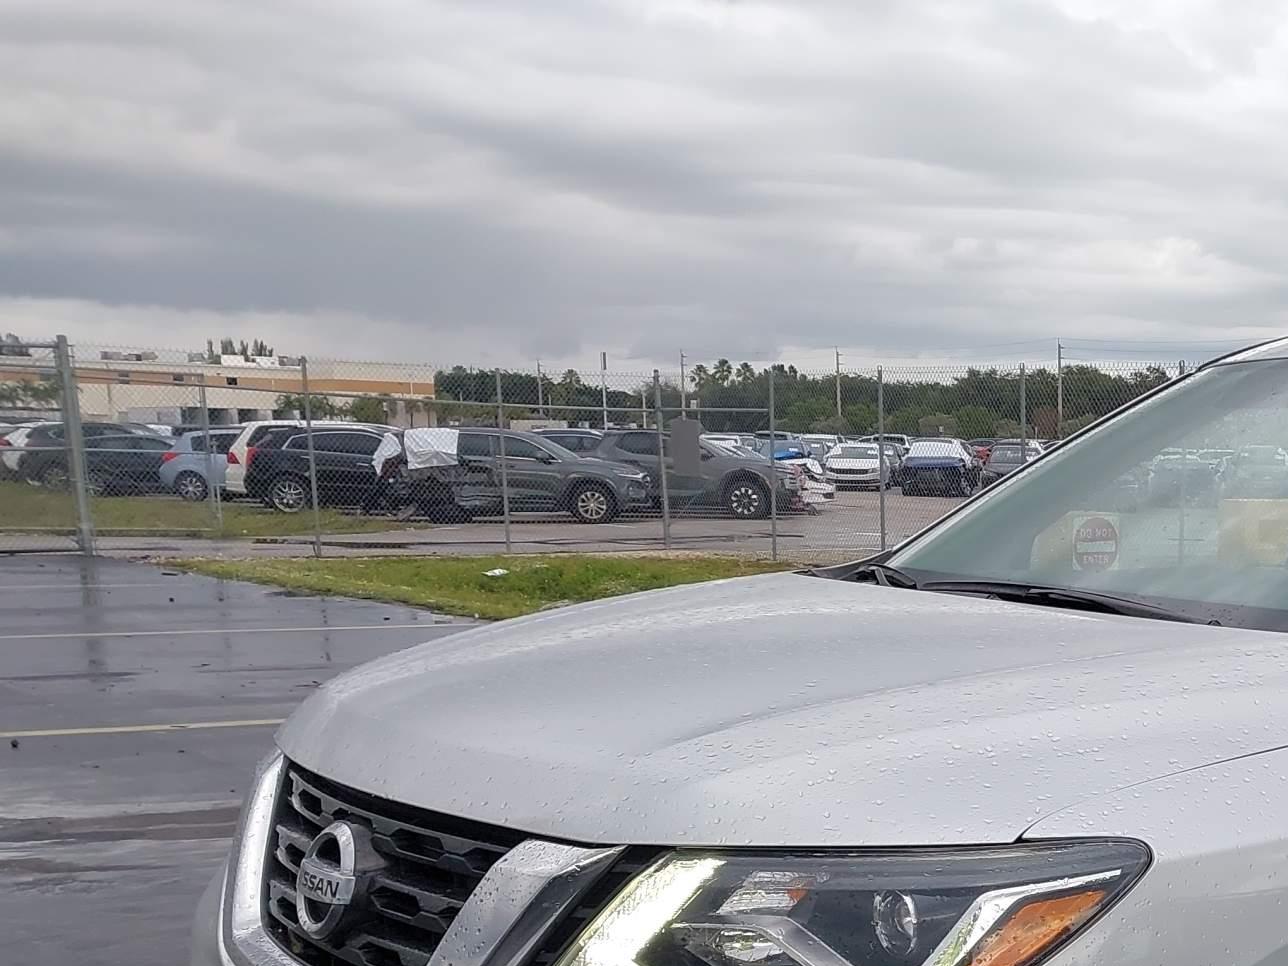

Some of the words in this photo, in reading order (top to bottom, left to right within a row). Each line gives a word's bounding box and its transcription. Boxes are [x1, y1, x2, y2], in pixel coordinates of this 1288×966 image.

[1080, 528, 1092, 538] DO
[1095, 528, 1114, 537] NOT
[1083, 554, 1109, 564] ENTER
